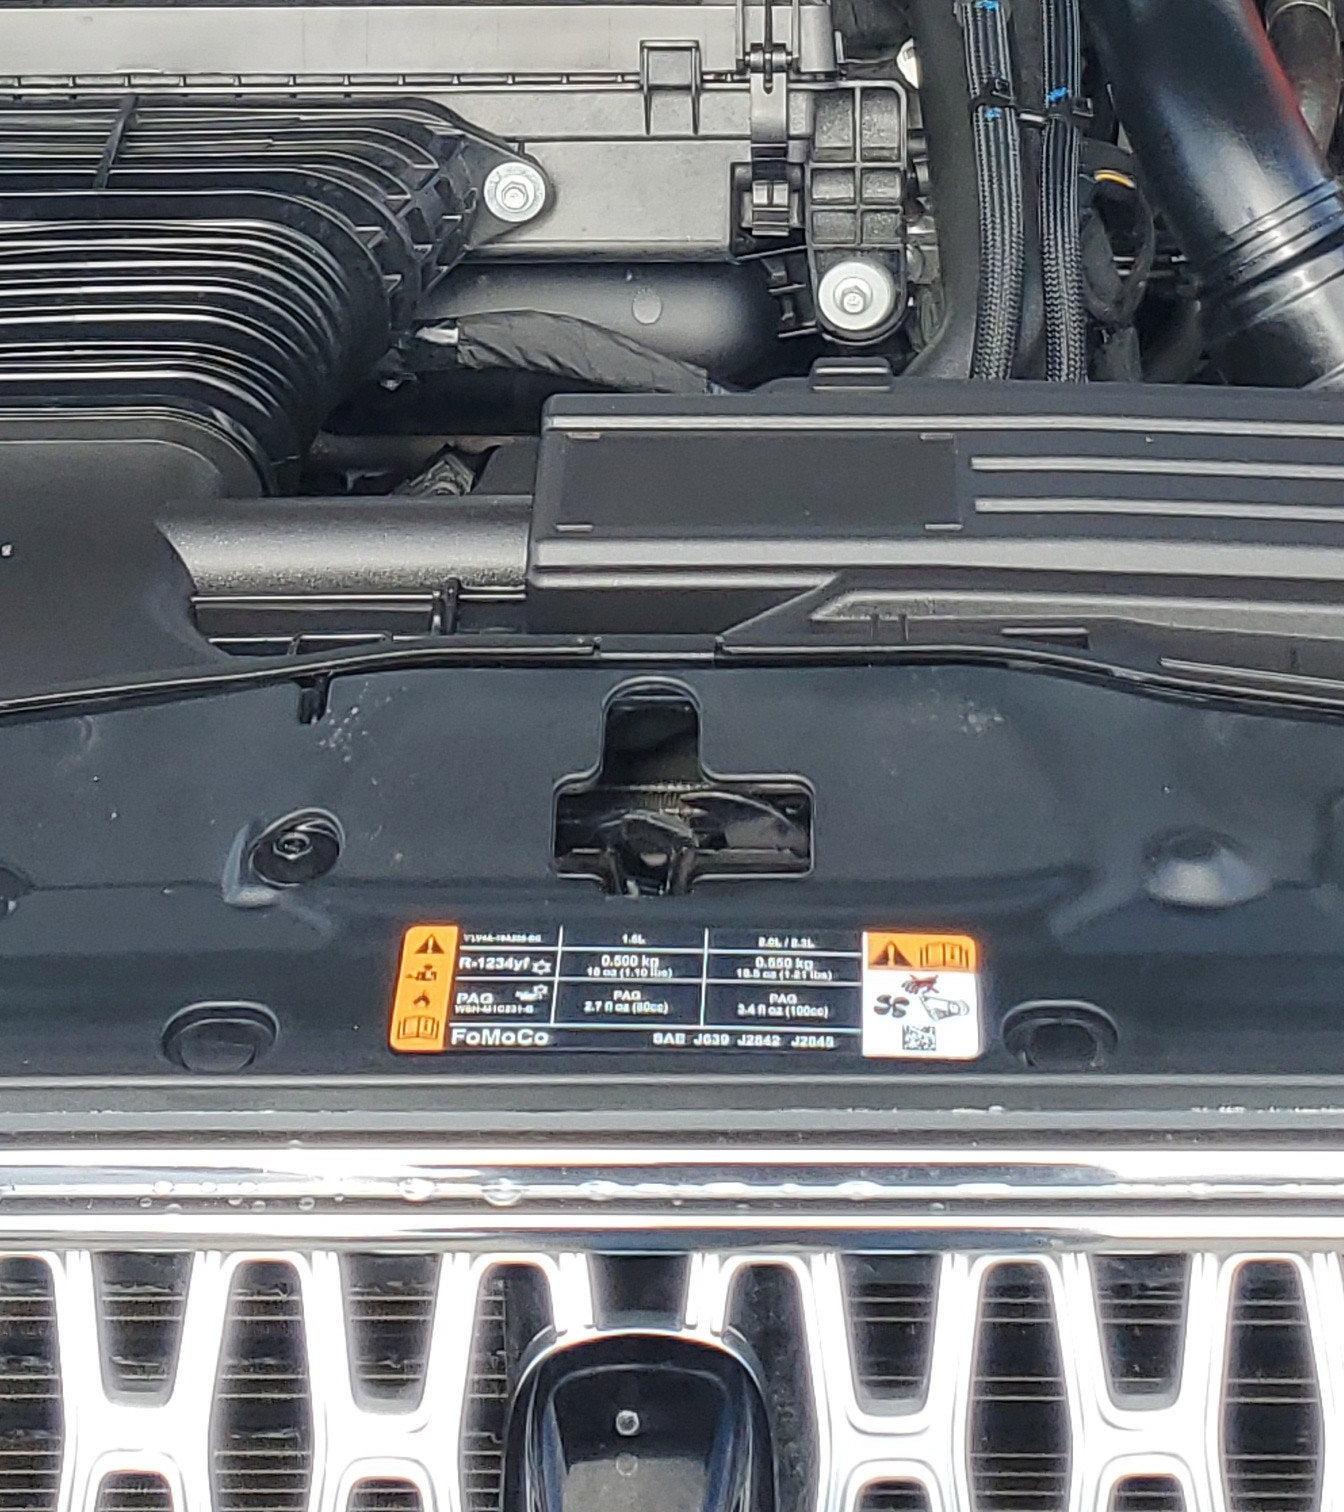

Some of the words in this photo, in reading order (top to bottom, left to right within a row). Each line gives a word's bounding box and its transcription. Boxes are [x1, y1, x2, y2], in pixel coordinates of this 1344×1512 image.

[459, 957, 531, 972] R-1234yf
[601, 954, 638, 967] 0.500
[641, 955, 659, 970] kg
[456, 992, 494, 1005] PAG
[613, 990, 642, 1001] PAG
[769, 993, 798, 1005] PAG
[451, 1028, 550, 1046] FoMoCo
